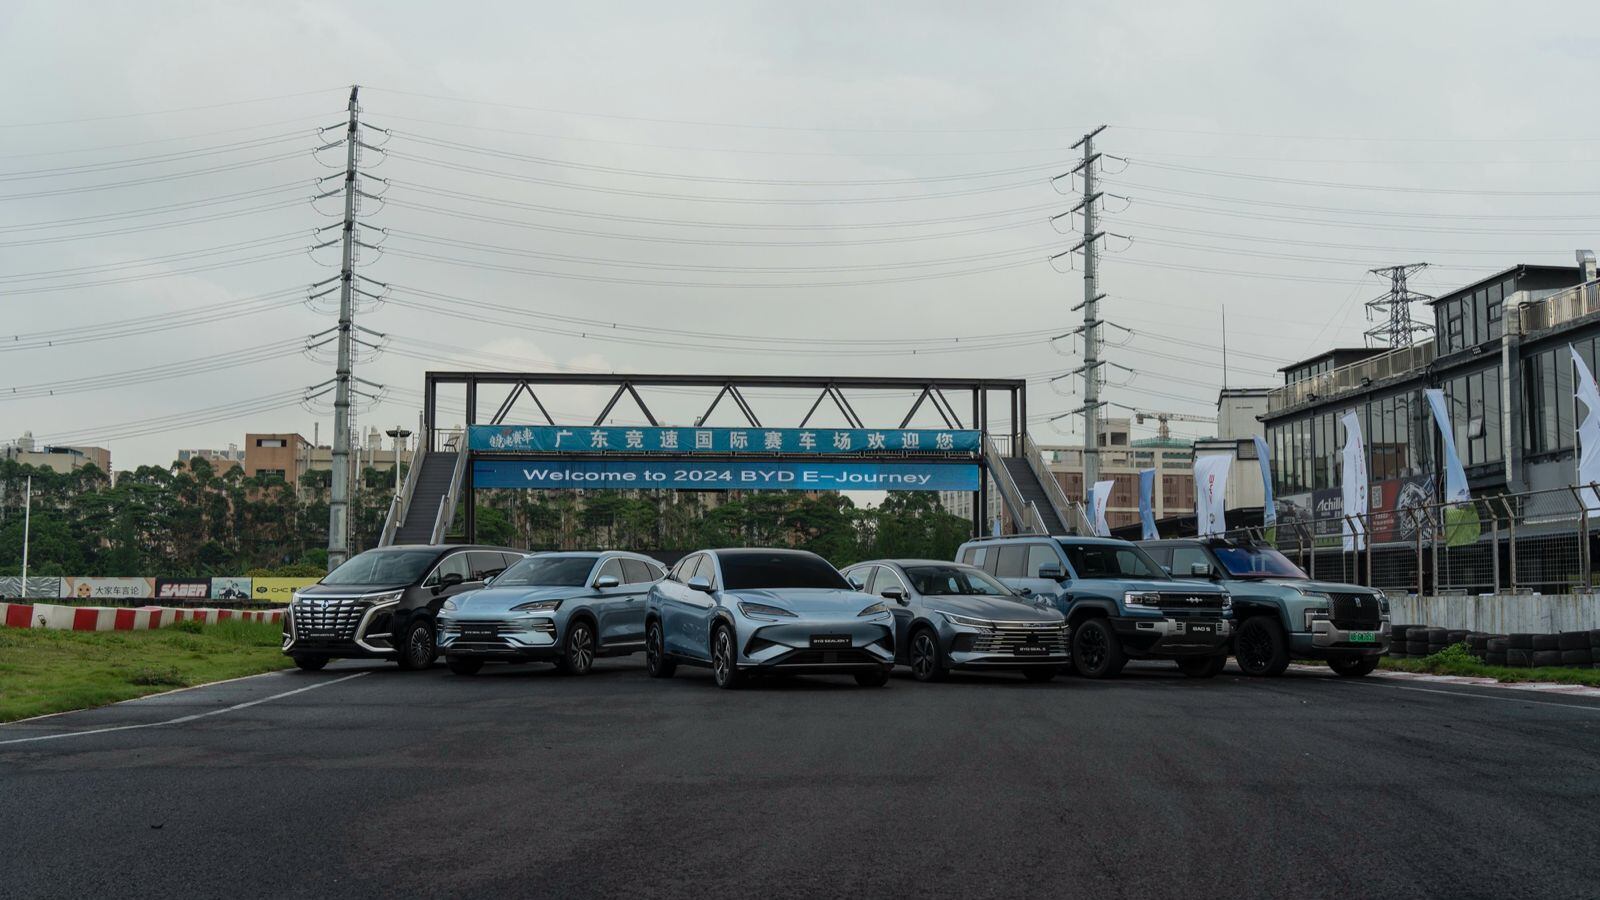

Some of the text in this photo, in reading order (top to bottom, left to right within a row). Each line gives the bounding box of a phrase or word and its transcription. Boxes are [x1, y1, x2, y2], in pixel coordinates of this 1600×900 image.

[554, 430, 954, 450] 广东竞速国际赛车场欢迎您
[523, 469, 932, 485] Welcome to 2024 BYD E-Journey
[95, 586, 140, 597] 大家车言论
